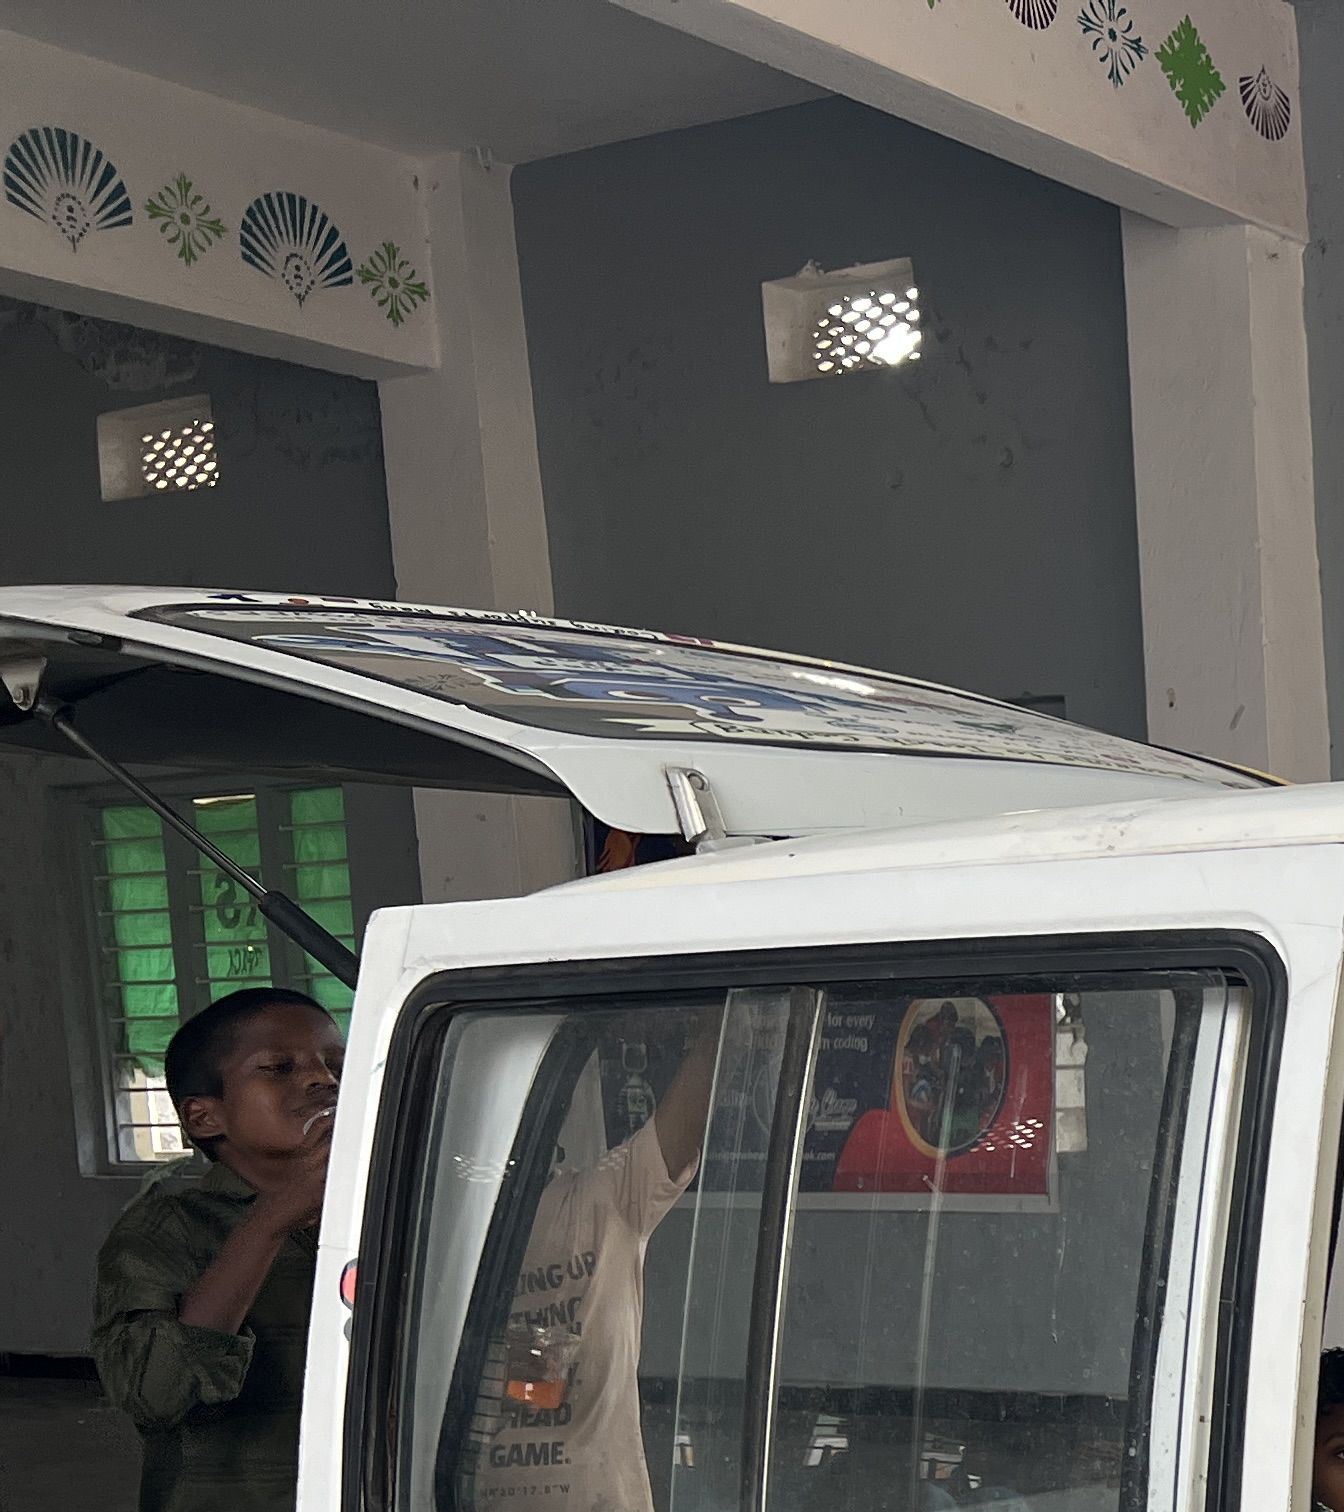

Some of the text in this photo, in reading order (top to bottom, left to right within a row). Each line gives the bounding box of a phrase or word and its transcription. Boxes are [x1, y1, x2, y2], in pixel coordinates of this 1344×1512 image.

[370, 602, 432, 615] many
[449, 607, 556, 628] supports
[569, 621, 660, 641] Coding
[833, 1036, 868, 1052] coding
[516, 1251, 596, 1296] ING UP
[490, 1441, 571, 1468] GAME.
